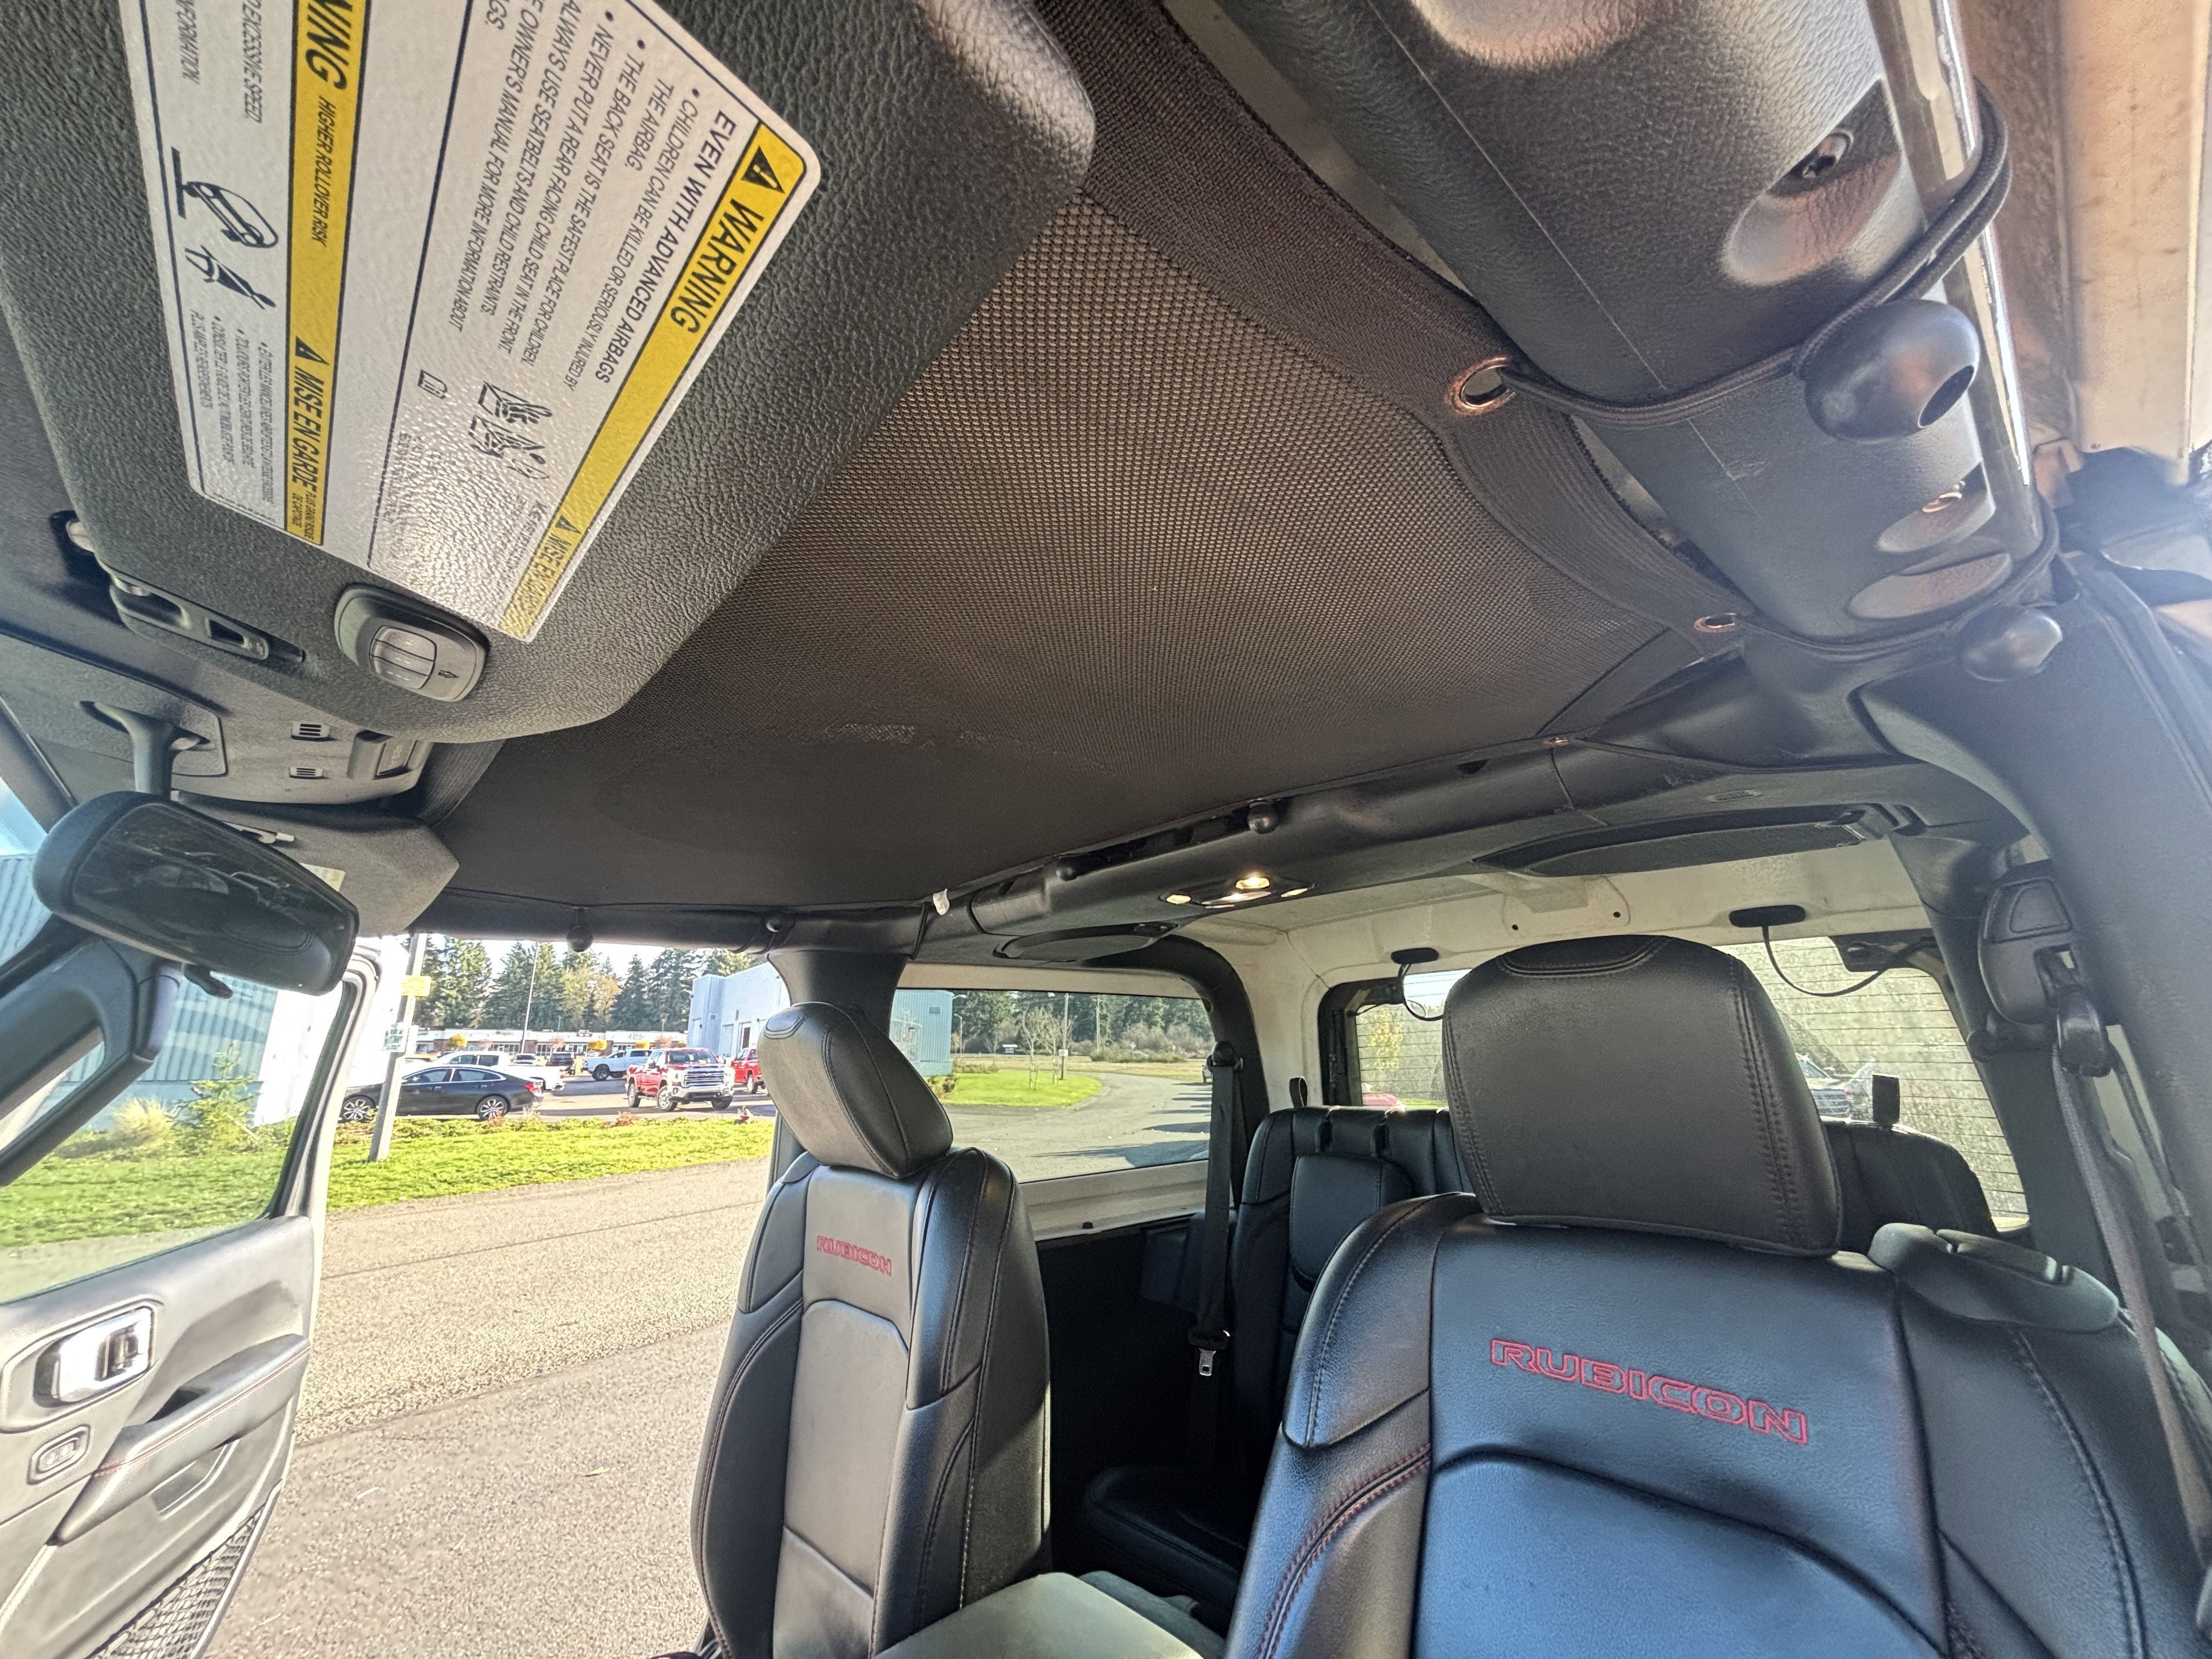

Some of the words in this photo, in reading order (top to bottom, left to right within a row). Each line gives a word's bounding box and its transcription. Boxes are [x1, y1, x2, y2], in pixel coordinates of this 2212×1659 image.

[172, 0, 200, 84] NFORMATION.
[241, 2, 262, 83] EXCESSIVE
[305, 0, 353, 89] NING
[504, 8, 539, 92] OWNER'S
[547, 0, 582, 72] ALWAYS
[579, 23, 614, 91] NEVER
[537, 67, 562, 109] USE
[618, 52, 645, 94] THE
[571, 84, 595, 126] PUT
[601, 86, 631, 139] BACK
[647, 77, 675, 117] THE
[316, 94, 336, 154] HIGHER
[489, 88, 520, 154] MANUAL
[565, 116, 584, 144] A
[624, 108, 659, 171] AIRBAG.
[654, 98, 698, 180] CHILDREN
[515, 102, 552, 188] SEATBELTS
[553, 130, 580, 177] REAR
[589, 132, 616, 177] SEAT
[693, 109, 737, 179] EVEN
[312, 148, 333, 219] ROLLOVER
[482, 150, 505, 186] FOR
[583, 169, 602, 190] IS
[473, 180, 497, 225] MORE
[508, 180, 529, 216] AND
[538, 171, 567, 224] FACING
[573, 187, 597, 218] THE
[641, 174, 665, 210] CAN
[667, 176, 707, 233] WITH
[311, 215, 328, 247] RISK
[498, 211, 522, 252] CHILD
[633, 203, 653, 229] BE
[456, 219, 488, 300] INFORMATION
[527, 221, 551, 260] CHILD
[558, 213, 586, 266] SAFEST
[616, 222, 645, 268] KILLED
[479, 246, 512, 316] RESTRAINTS.
[518, 256, 540, 291] SEAT
[545, 258, 570, 300] PLACE
[607, 264, 627, 287] OR
[625, 225, 679, 321] ADVANCED
[670, 198, 765, 334] WARNING
[448, 292, 469, 332] ABOUT
[507, 298, 527, 323] THE
[514, 284, 531, 302] IN
[537, 294, 557, 321] FOR
[584, 282, 618, 342] SERIOUSLY
[497, 317, 520, 354] FRONT.
[520, 317, 549, 367] CHILDREN.
[567, 336, 595, 378] INJURED
[594, 316, 635, 383] AIRBAGS
[293, 365, 324, 419] MISE
[563, 374, 578, 392] BY
[292, 409, 321, 443] EN
[291, 436, 320, 493] GARDE
[291, 492, 304, 503] DE
[304, 490, 317, 507] PLUS
[304, 504, 316, 523] GRAND
[303, 521, 315, 540] RISQUE
[816, 1235, 892, 1277] RUBICON
[1489, 1339, 1809, 1446] RUBICON
